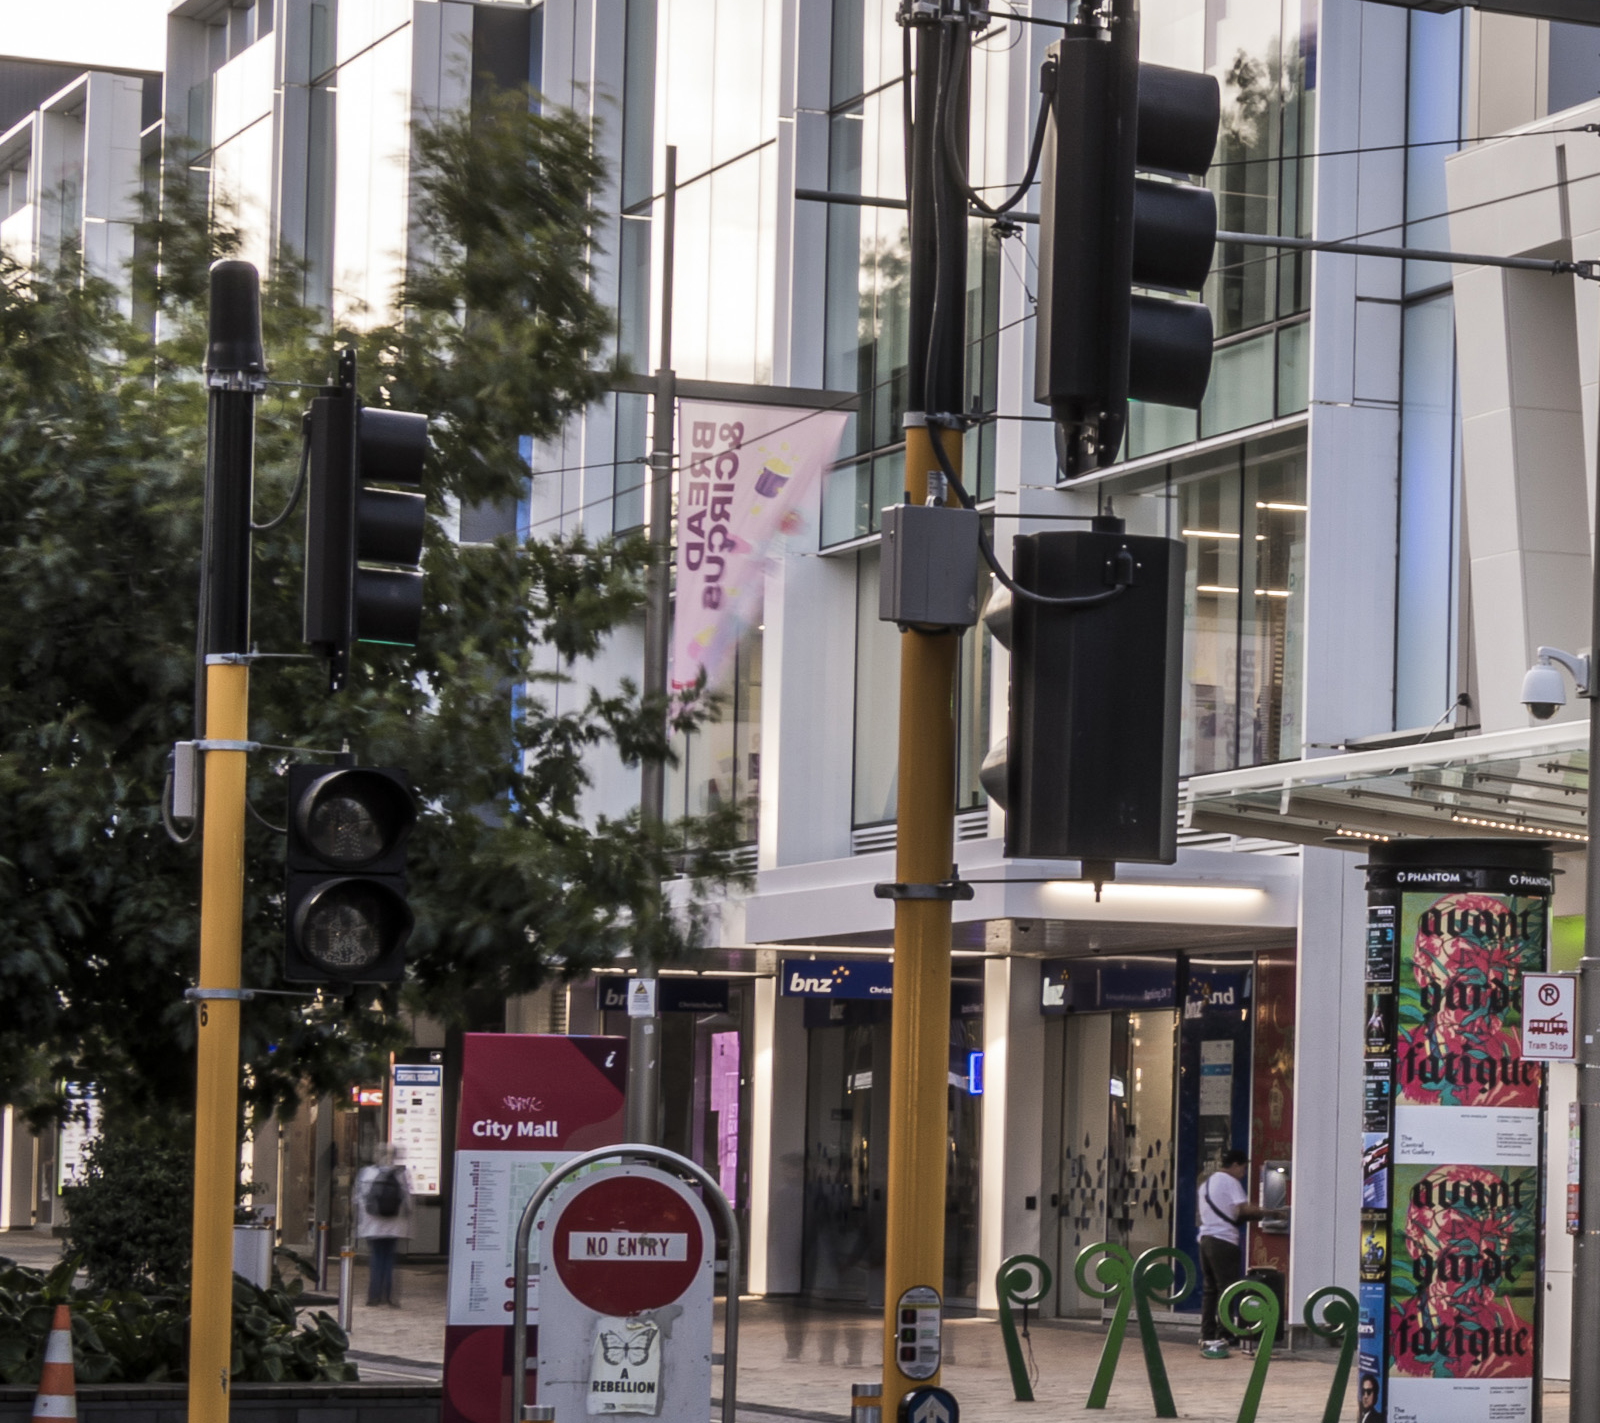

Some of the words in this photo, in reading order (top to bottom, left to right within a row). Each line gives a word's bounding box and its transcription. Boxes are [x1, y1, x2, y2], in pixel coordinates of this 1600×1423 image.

[1407, 872, 1460, 882] PHANTOM
[790, 972, 832, 994] bnz
[200, 1003, 208, 1027] 6
[1528, 1041, 1548, 1050] Tram
[1550, 1041, 1568, 1051] Stop
[472, 1119, 513, 1141] City
[517, 1120, 558, 1138] Mall
[1401, 1141, 1424, 1149] Central
[586, 1237, 608, 1256] NO
[617, 1237, 670, 1257] ENTRY
[620, 1368, 629, 1379] A
[592, 1380, 656, 1394] REBELLION
[1393, 1414, 1417, 1422] Central
